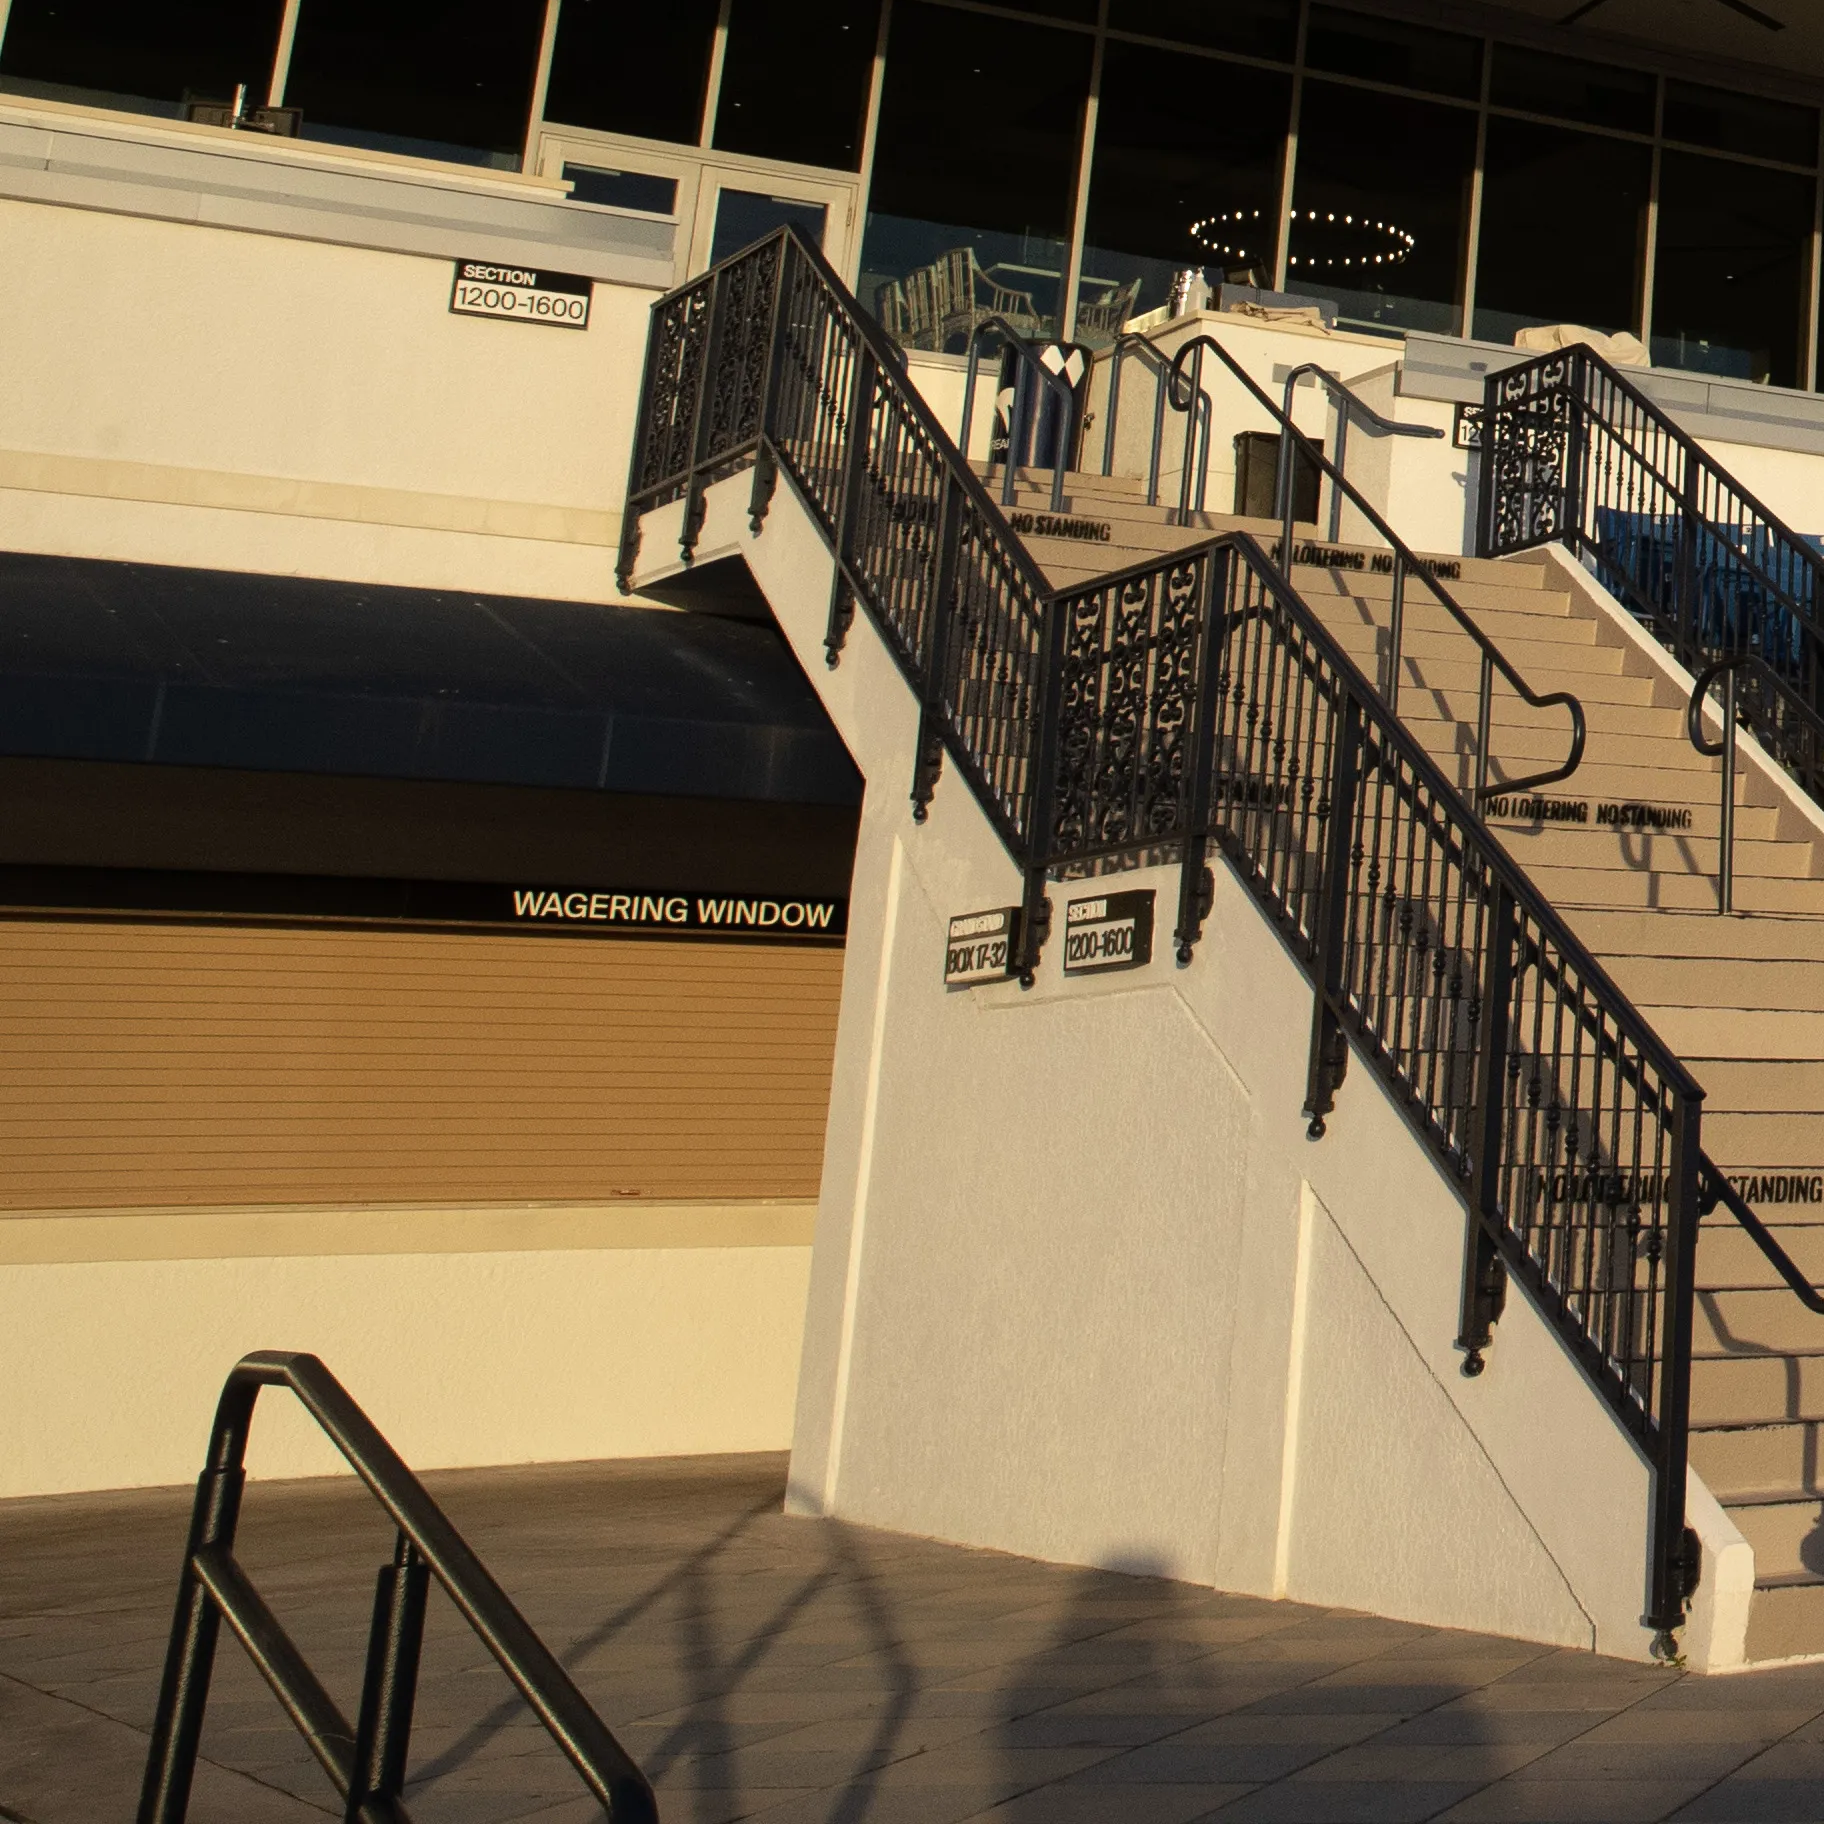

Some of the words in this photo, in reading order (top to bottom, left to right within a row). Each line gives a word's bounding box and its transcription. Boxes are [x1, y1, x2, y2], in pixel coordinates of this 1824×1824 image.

[463, 264, 537, 286] SECTION
[459, 286, 585, 320] 1200-1600
[513, 890, 689, 923] WAGERING
[697, 898, 835, 928] WINDOW
[948, 943, 975, 974] BOX
[976, 940, 1007, 970] 17-32
[1068, 926, 1135, 962] 1200-1600
